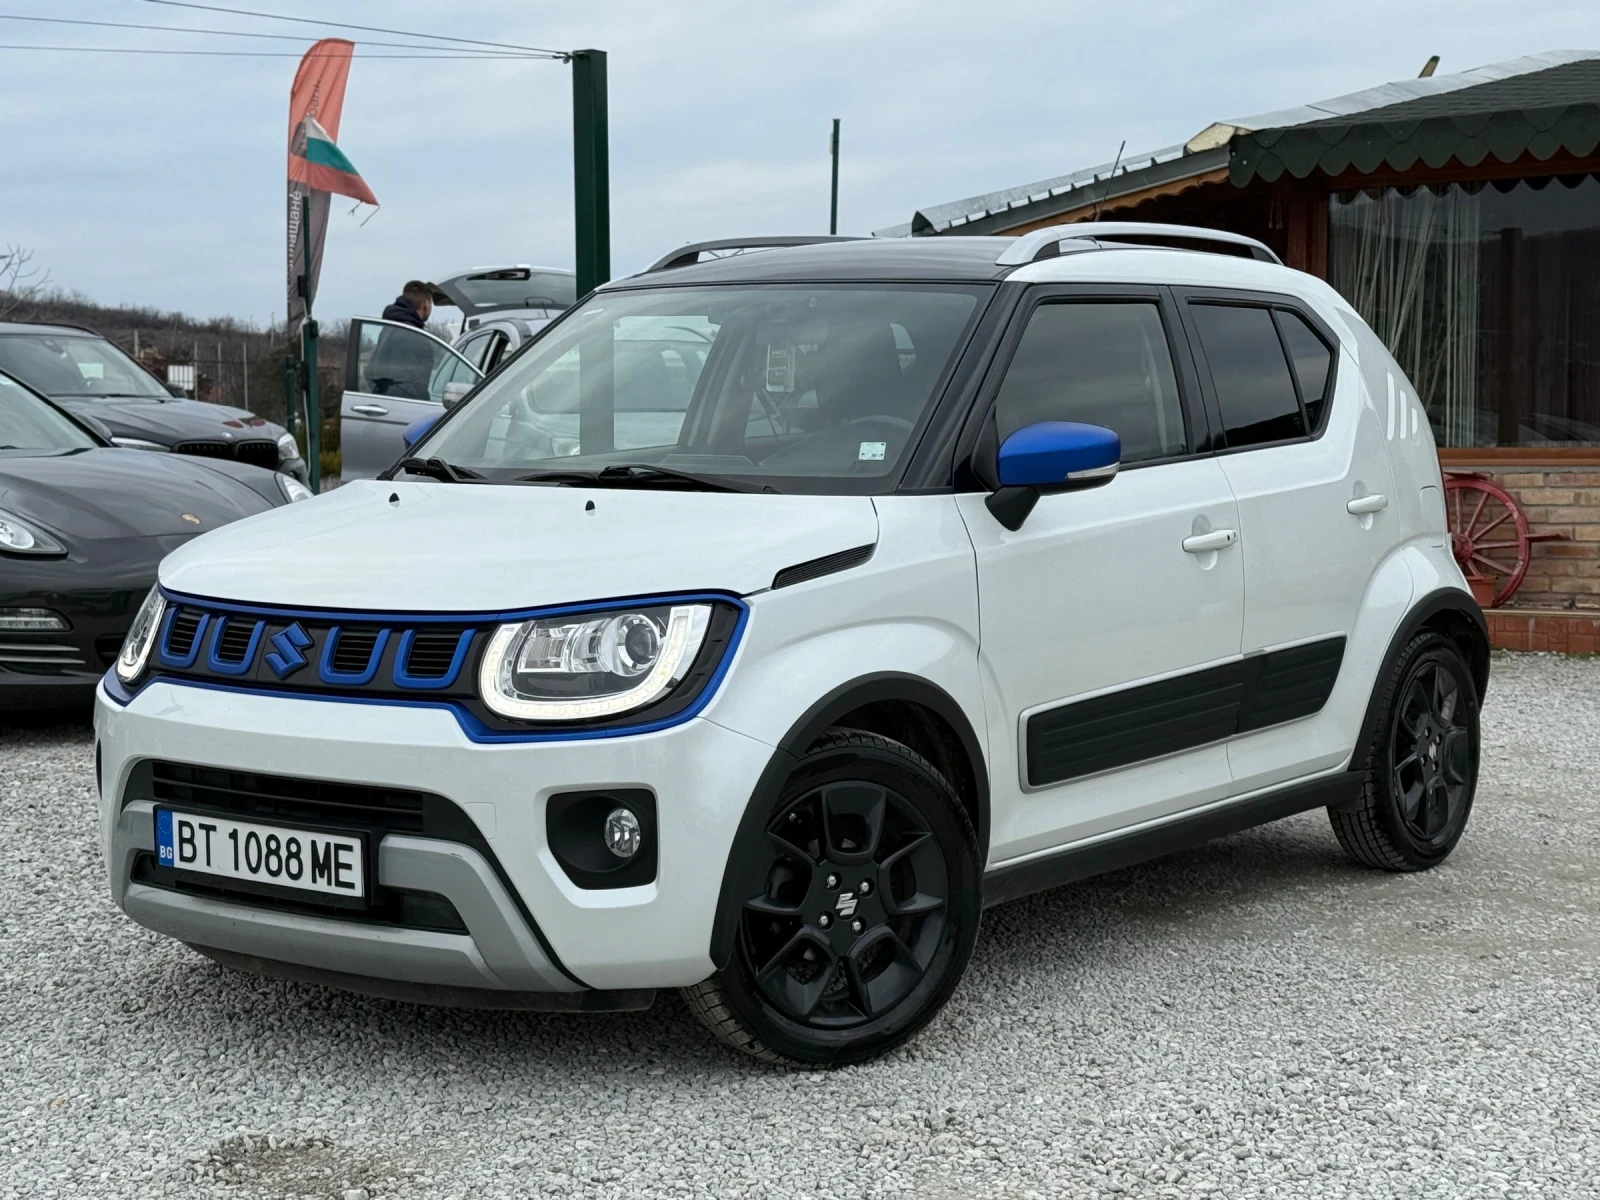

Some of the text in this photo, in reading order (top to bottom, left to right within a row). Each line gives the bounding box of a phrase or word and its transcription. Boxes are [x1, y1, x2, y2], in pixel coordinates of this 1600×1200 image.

[160, 845, 173, 860] BG
[178, 820, 356, 890] BT 1088 ME
